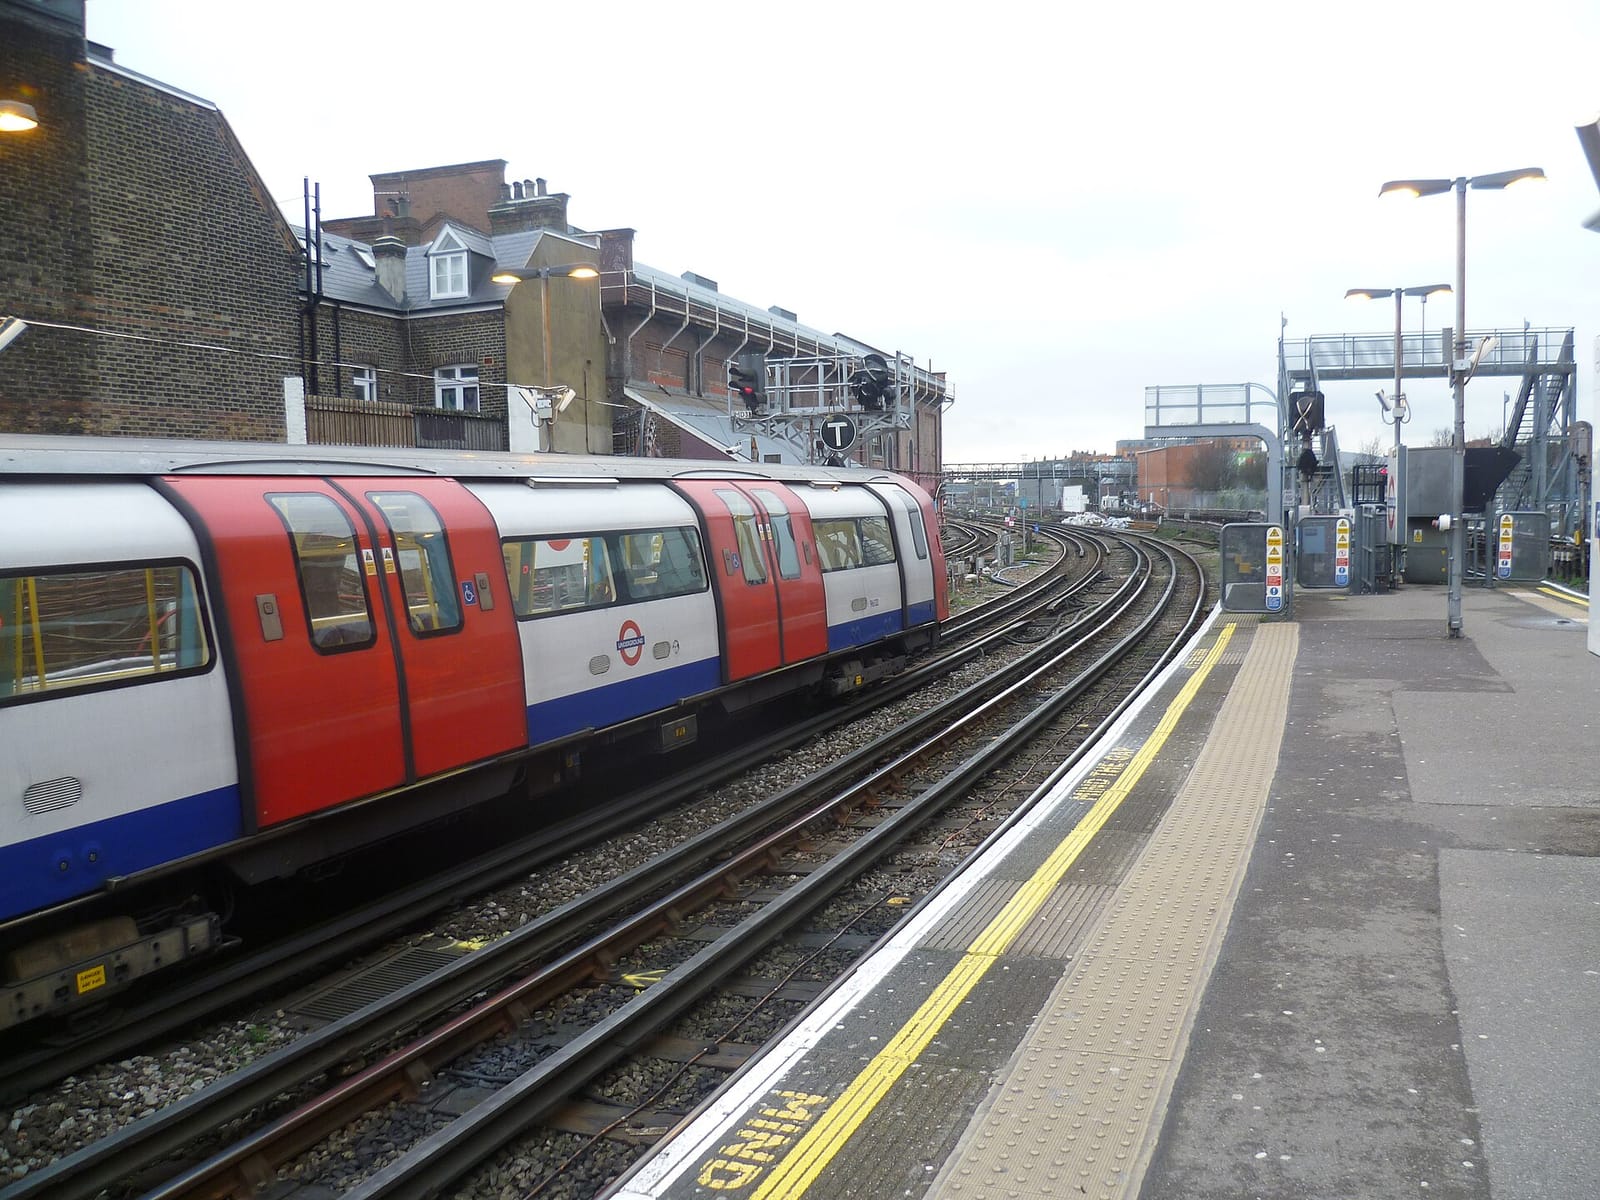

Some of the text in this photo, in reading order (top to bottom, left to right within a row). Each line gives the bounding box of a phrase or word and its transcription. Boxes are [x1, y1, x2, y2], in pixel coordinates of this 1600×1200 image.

[827, 421, 848, 447] T
[1089, 763, 1124, 777] THE
[1069, 779, 1110, 800] MIND
[696, 1089, 828, 1190] MIND
